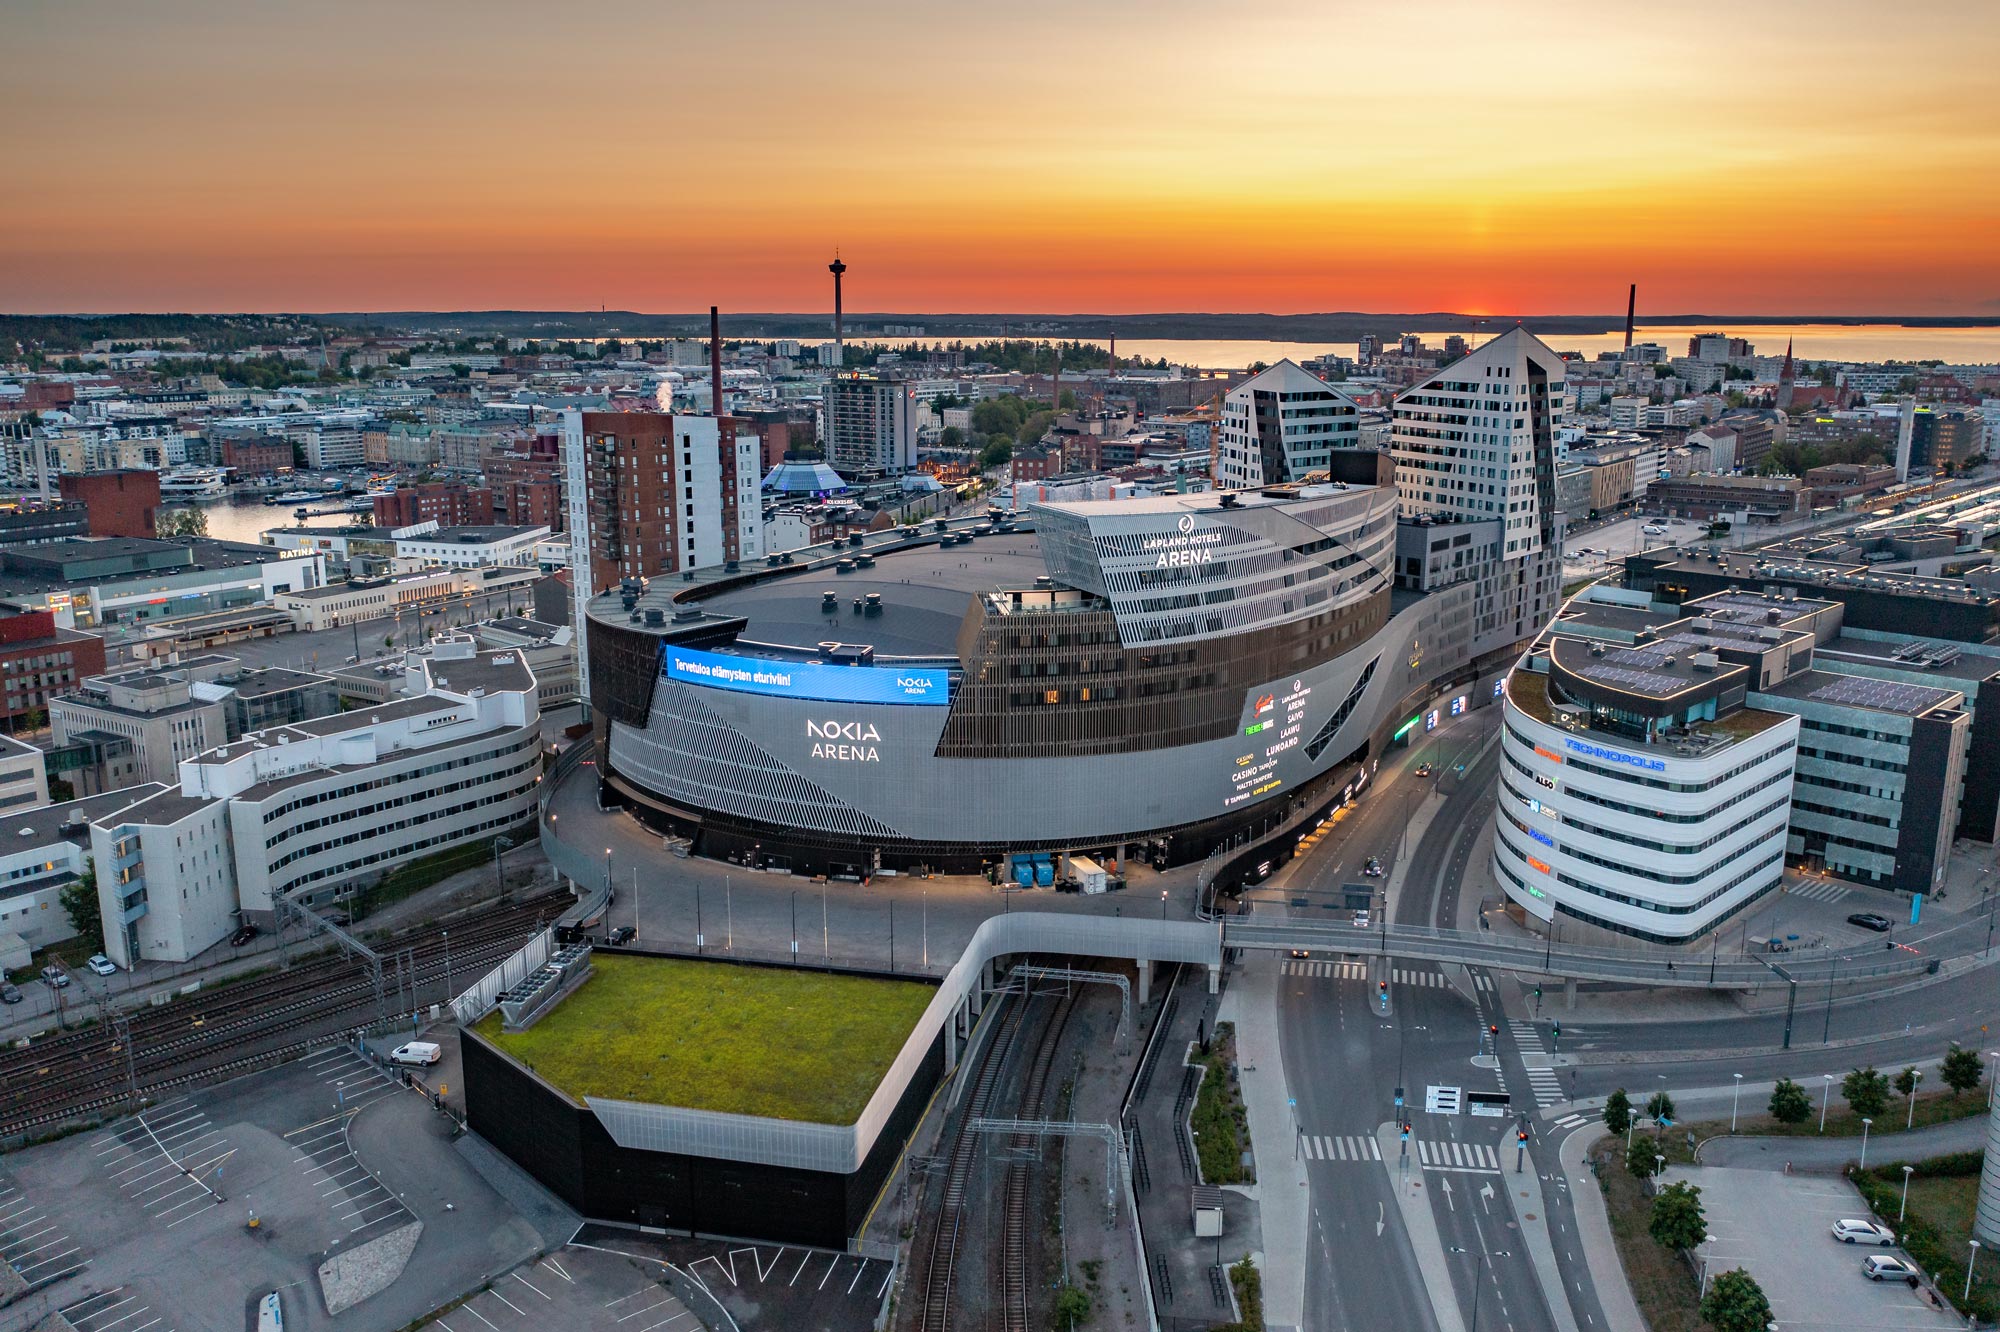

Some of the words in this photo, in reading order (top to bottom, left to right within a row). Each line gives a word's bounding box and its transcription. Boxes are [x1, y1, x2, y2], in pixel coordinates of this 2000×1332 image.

[1144, 537, 1188, 548] LAPLAND
[1190, 533, 1221, 543] HOTELS
[280, 548, 315, 560] RATINA
[1156, 548, 1212, 567] ARENA
[675, 658, 710, 676] Tervetuloa
[711, 665, 751, 685] elämysten
[897, 678, 932, 687] NOKIA
[1287, 698, 1305, 712] ARENA
[807, 719, 881, 742] NOKIA
[811, 743, 880, 762] ARENA
[1565, 738, 1665, 771] TECHNOPOLIS
[1232, 766, 1258, 782] CASINO
[1535, 775, 1554, 789] ALSO
